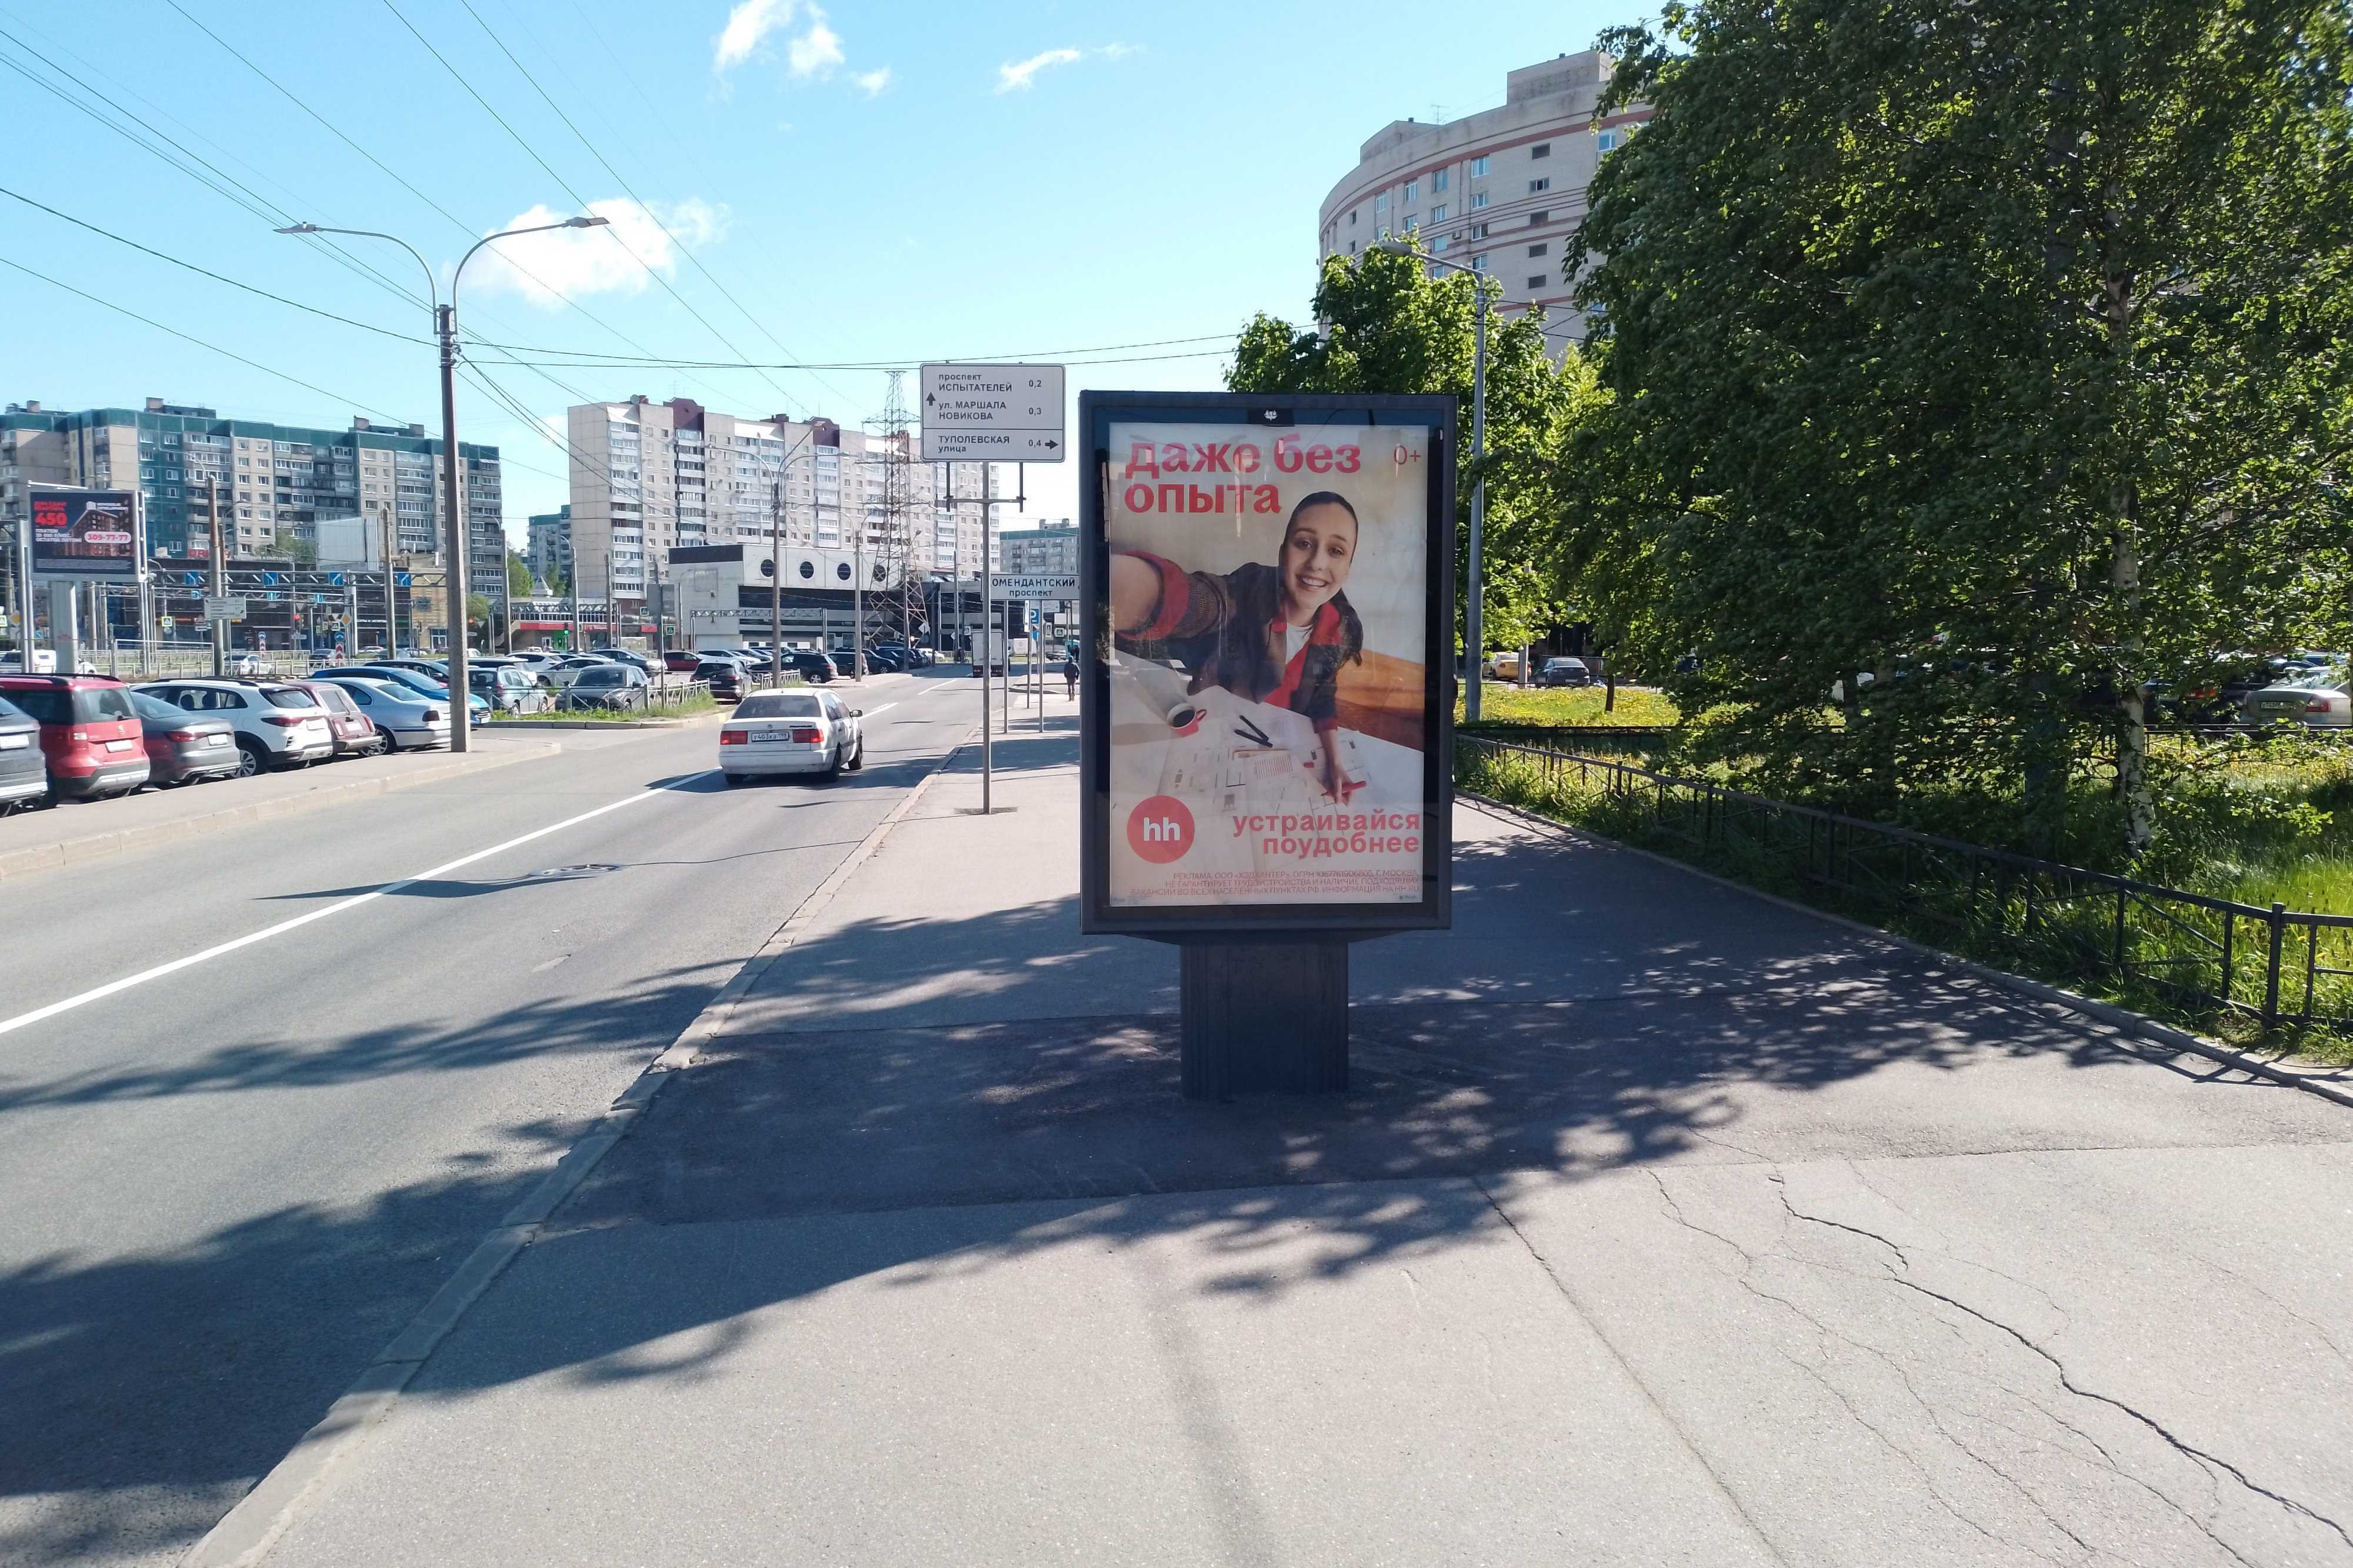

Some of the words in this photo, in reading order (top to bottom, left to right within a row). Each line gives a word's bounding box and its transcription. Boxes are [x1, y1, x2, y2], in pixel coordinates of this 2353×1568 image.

[939, 382, 1012, 392] ИСПЫТАТЕЛЕЙ
[1029, 380, 1042, 388] 0,2
[1029, 408, 1042, 416] 0,3
[939, 436, 1009, 444] ТУПОЛЕВСКАЯ
[1125, 442, 1261, 479] даже
[1274, 433, 1361, 473] без
[1394, 445, 1421, 465] 0+
[1125, 483, 1281, 513] опыта
[35, 513, 67, 525] 450
[992, 577, 1075, 587] ОМЕНДАНТСКИЙ
[1143, 817, 1180, 842] hh
[1233, 809, 1420, 838] устраивайся
[1263, 832, 1419, 859] поудобнее
[1234, 879, 1311, 887] ТРУДОУСТРОЙСТВА
[1361, 877, 1419, 885] ПОДХОДЯЩИХ
